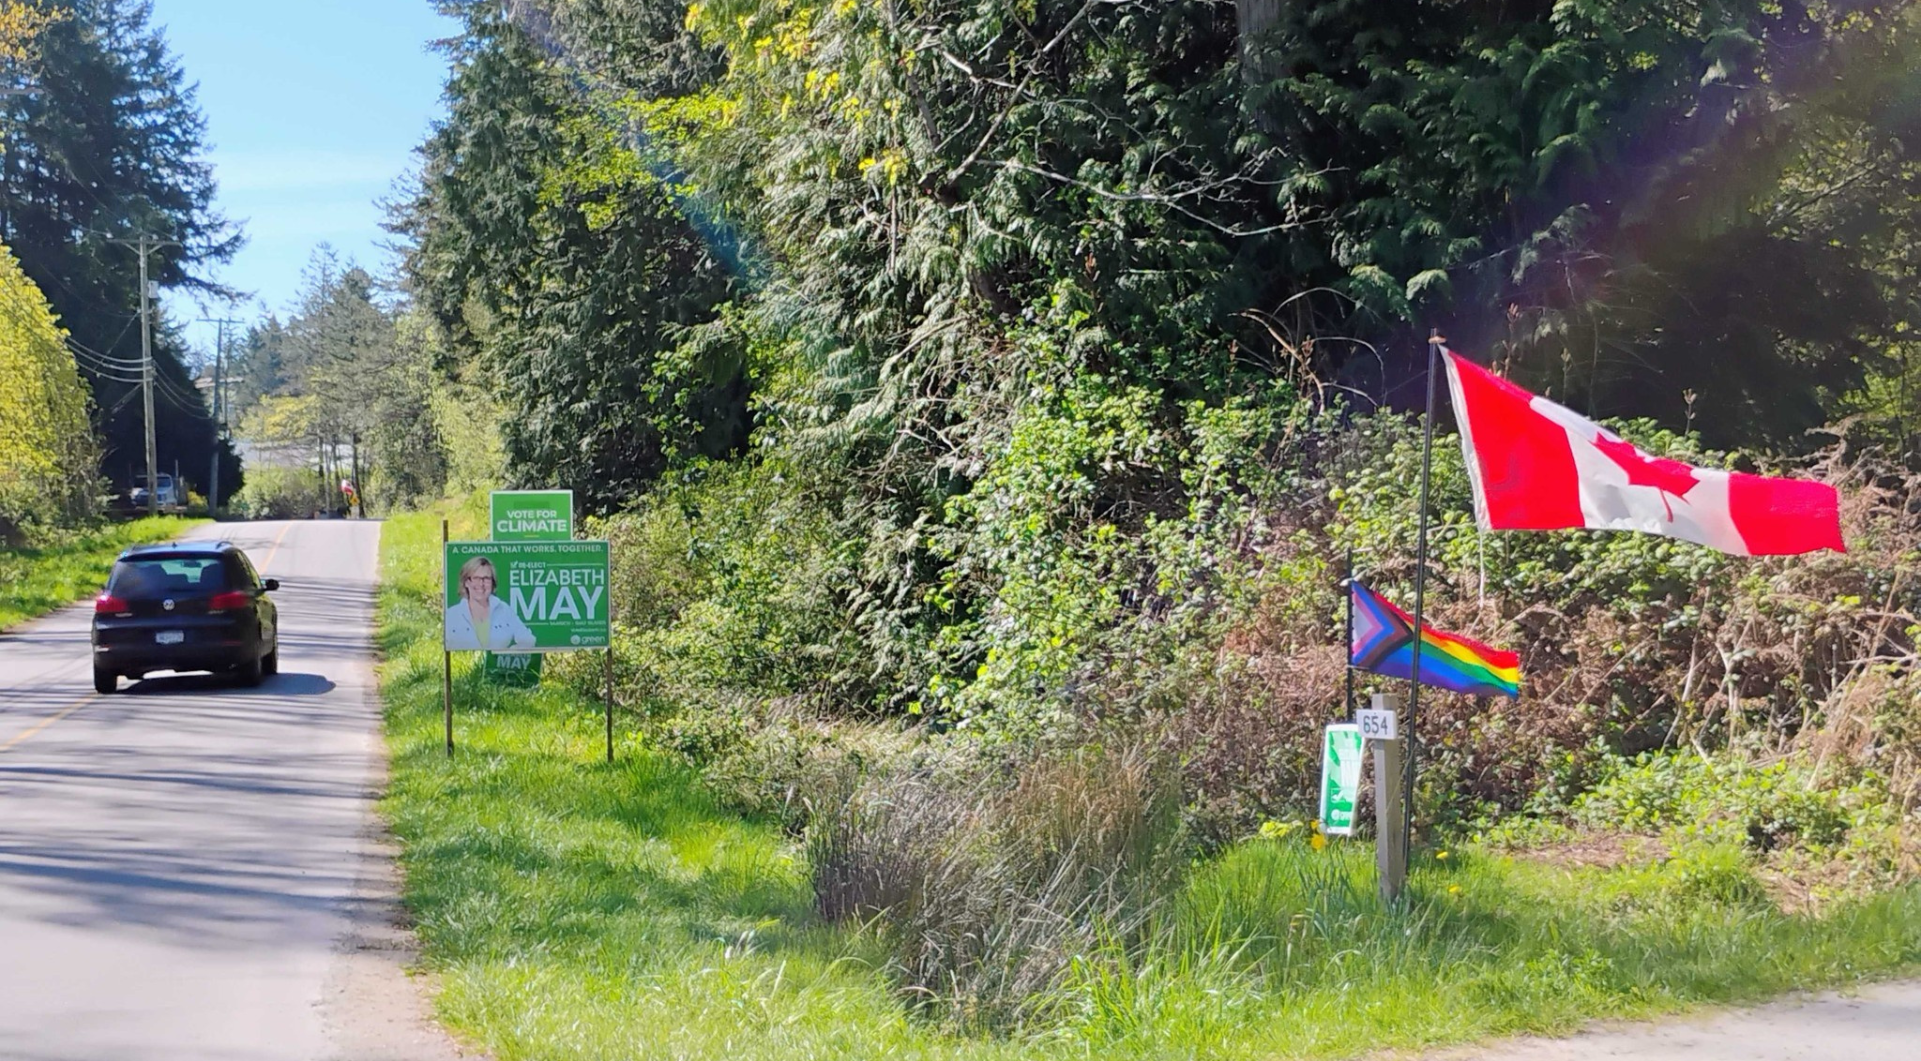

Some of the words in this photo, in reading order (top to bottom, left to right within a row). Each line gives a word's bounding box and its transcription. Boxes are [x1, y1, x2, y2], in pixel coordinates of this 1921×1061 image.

[507, 510, 535, 519] VOTE
[537, 510, 557, 519] FOR
[497, 519, 568, 533] CLIMATE
[452, 546, 459, 554] A
[461, 546, 499, 554] CANADA
[501, 545, 522, 553] THAT
[523, 545, 556, 553] WORKS.
[558, 545, 604, 553] TOGETHER.
[509, 569, 605, 586] ELIZABETH
[510, 586, 604, 620] MAY
[496, 656, 531, 670] MAY
[1363, 715, 1388, 735] 654
